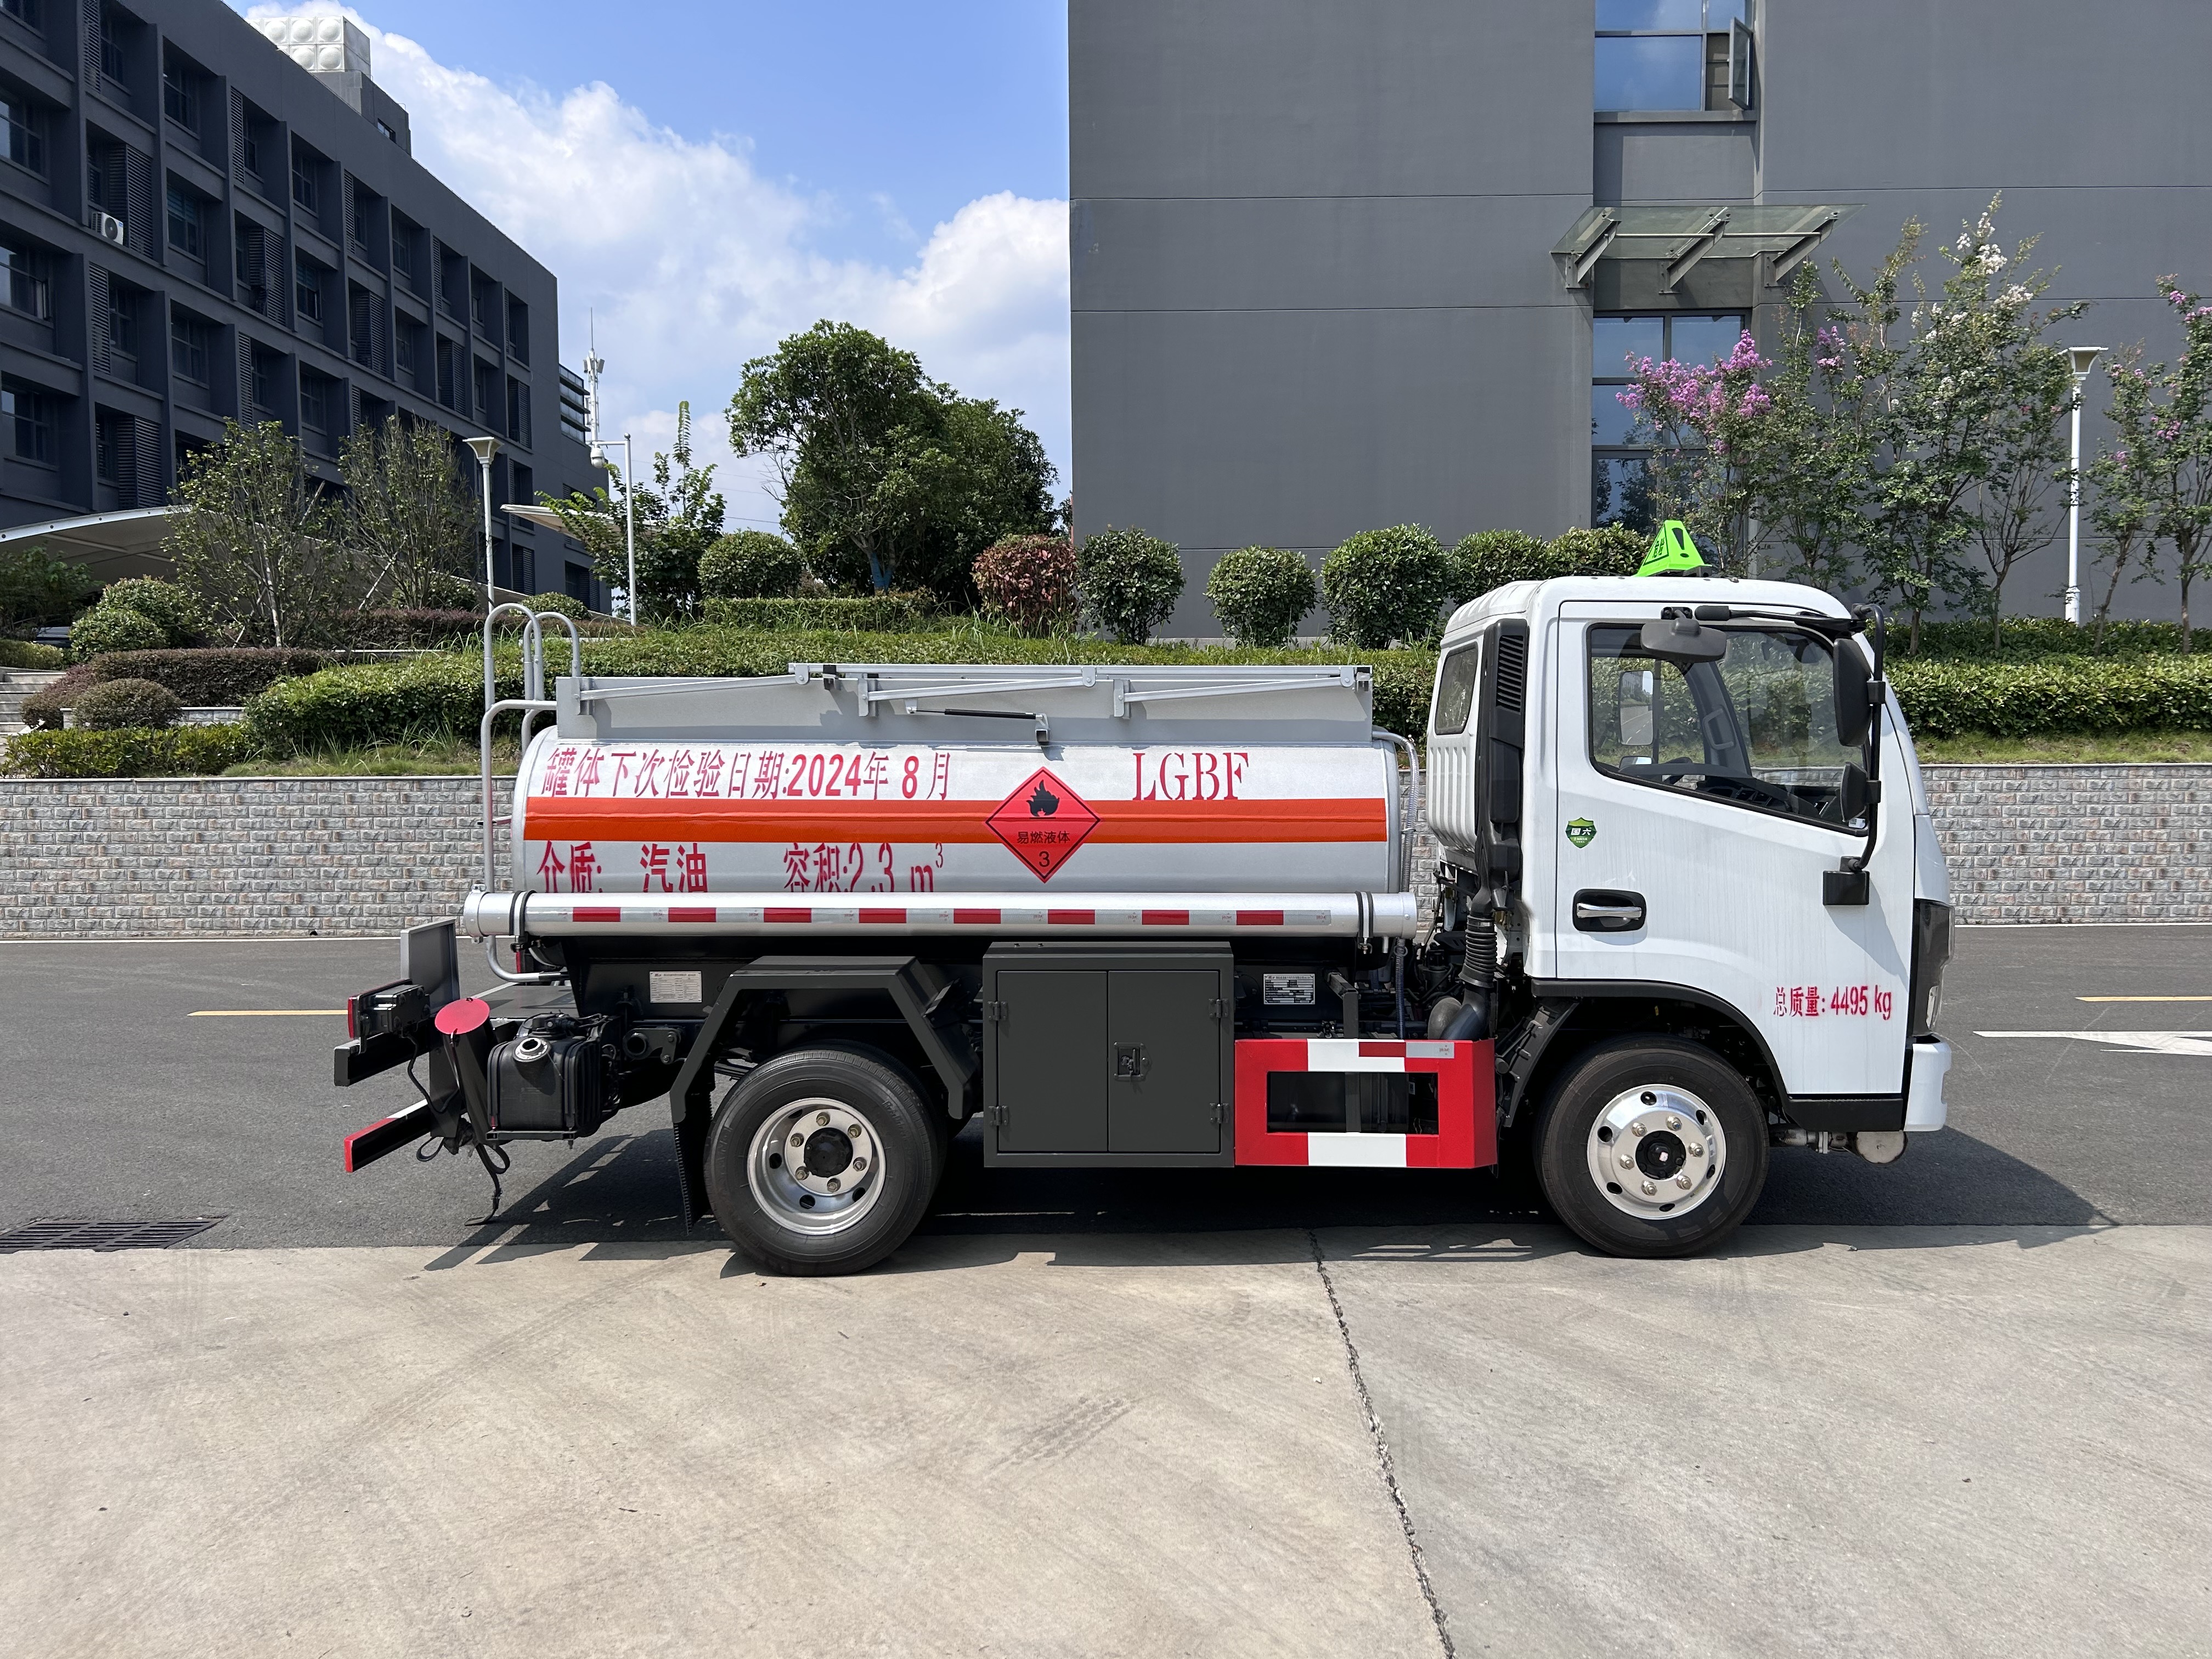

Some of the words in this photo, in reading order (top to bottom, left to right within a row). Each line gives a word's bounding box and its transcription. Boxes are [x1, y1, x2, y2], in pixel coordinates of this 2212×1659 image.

[1132, 752, 1249, 800] LGBF
[1017, 830, 1070, 844] 易燃液体
[1571, 827, 1592, 836] 国六
[640, 843, 708, 893] 汽油
[1039, 851, 1050, 867] 3
[1874, 985, 1892, 1020] kg
